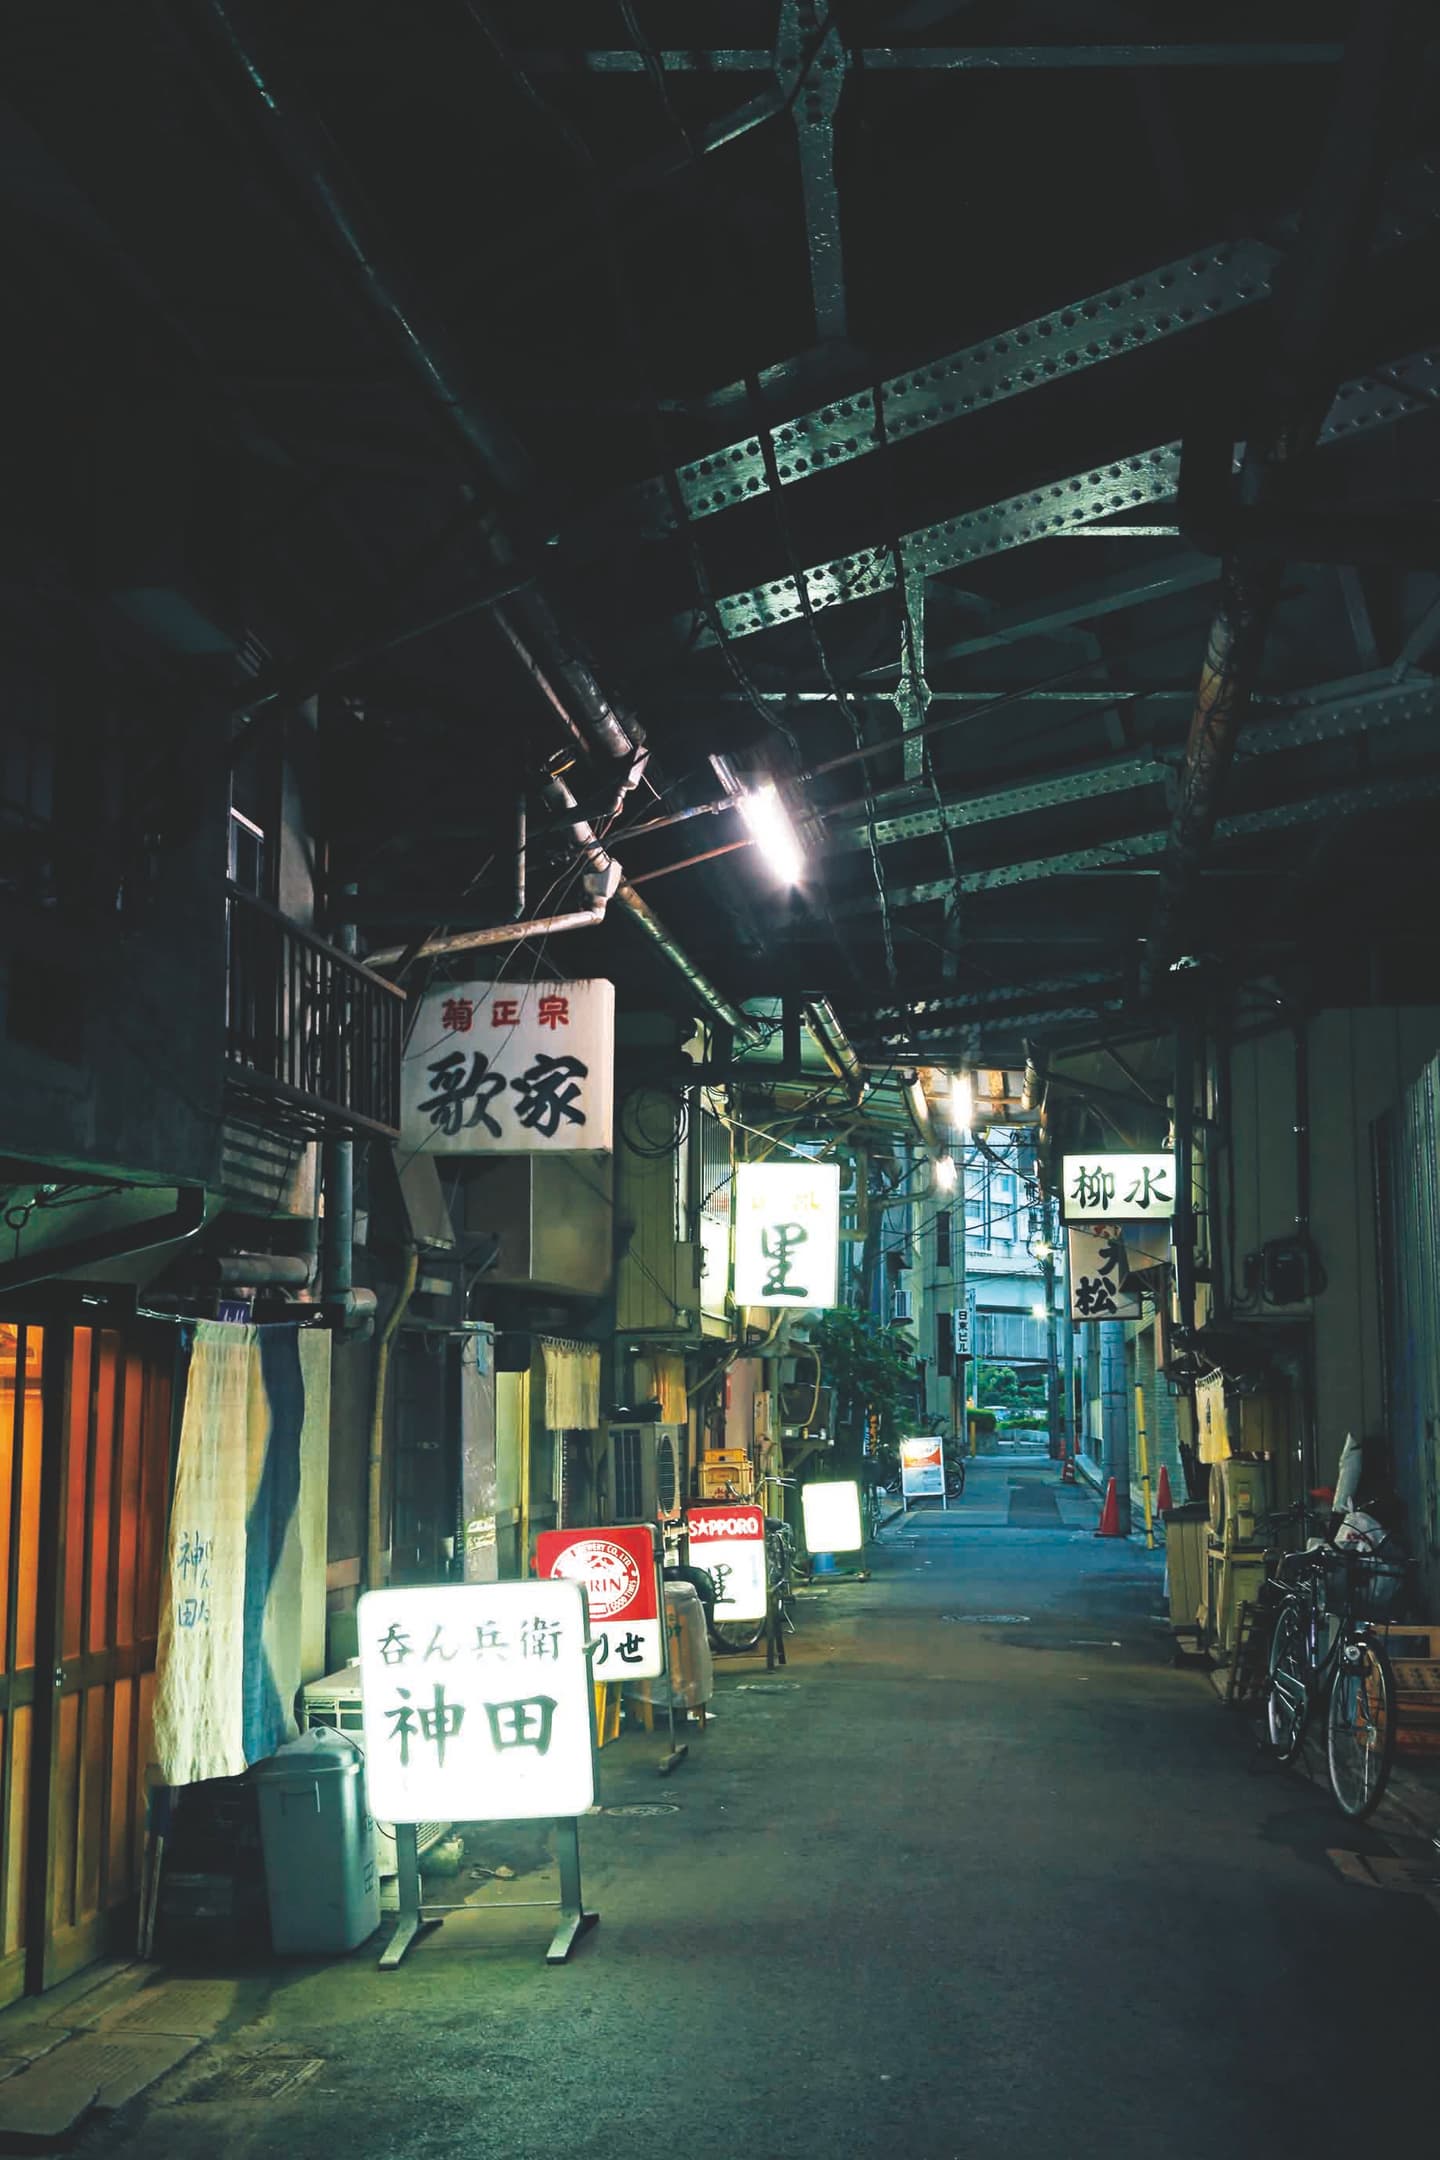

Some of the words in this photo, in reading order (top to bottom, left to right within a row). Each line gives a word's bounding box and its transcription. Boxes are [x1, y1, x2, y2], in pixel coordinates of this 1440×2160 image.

[443, 995, 569, 1032] 菊正宗
[417, 1051, 589, 1138] 歌家
[1070, 1165, 1174, 1211] 柳水
[761, 1222, 809, 1298] 里
[688, 1517, 759, 1537] SAPPORO
[177, 1529, 204, 1629] 神田
[583, 1578, 622, 1593] RIN
[383, 1683, 559, 1769] 神田
